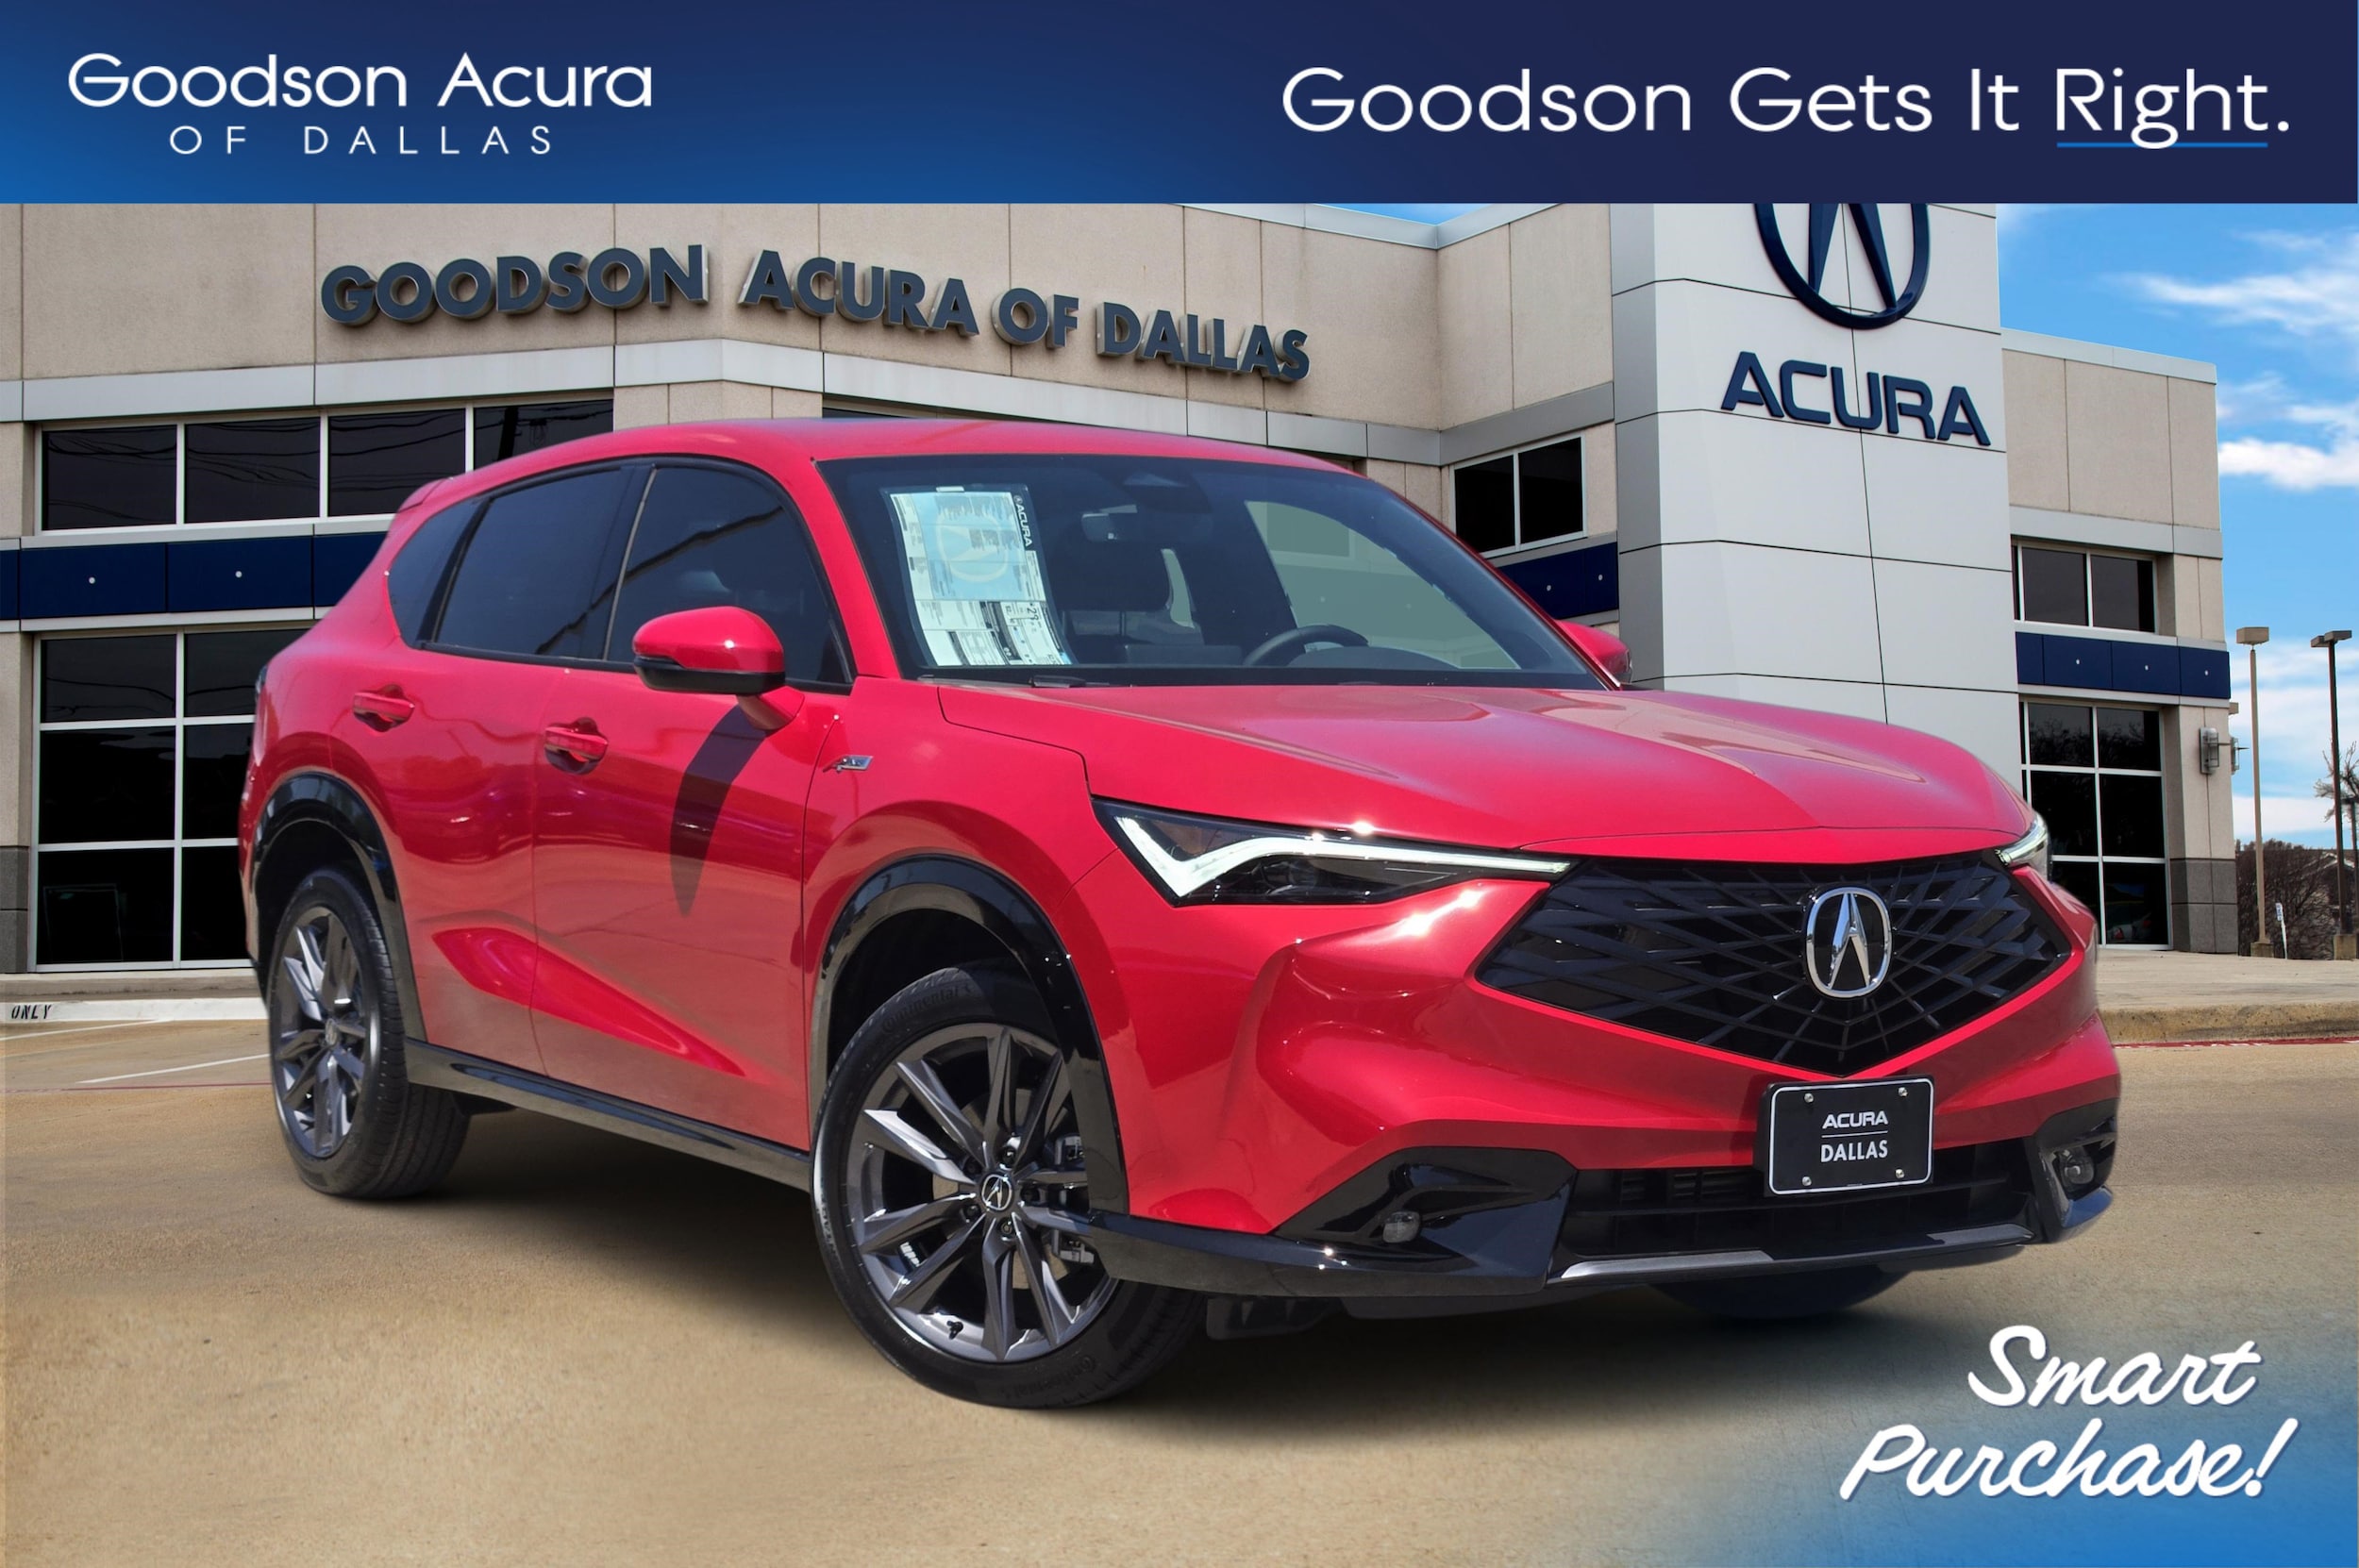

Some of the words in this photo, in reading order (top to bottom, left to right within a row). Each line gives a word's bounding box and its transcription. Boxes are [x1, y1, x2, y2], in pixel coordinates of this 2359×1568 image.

[321, 243, 710, 326] GOODSON
[739, 249, 979, 337] ACURA
[991, 288, 1079, 349] OF
[1096, 302, 1311, 381] DALLAS
[1721, 351, 1991, 446] ACURA
[1015, 504, 1033, 547] ACURA
[11, 1004, 52, 1020] ONLY
[1821, 1110, 1889, 1129] ACURA
[1820, 1139, 1888, 1163] DALLAS
